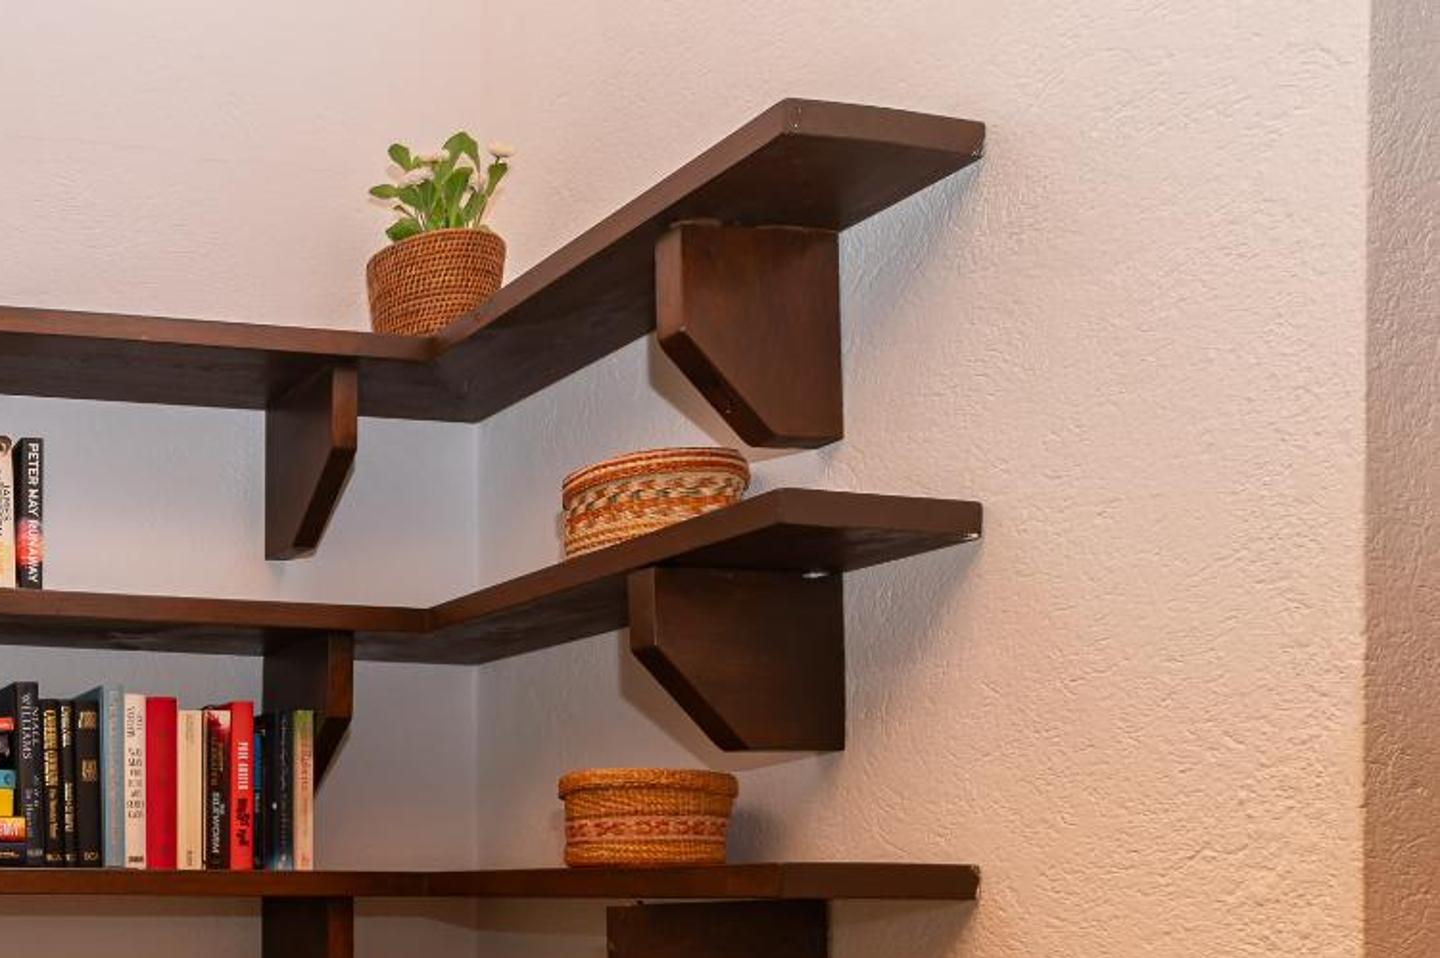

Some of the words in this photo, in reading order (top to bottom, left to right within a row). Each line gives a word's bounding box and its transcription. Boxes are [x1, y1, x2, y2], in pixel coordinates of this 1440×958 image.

[28, 442, 39, 485] PETER
[2, 484, 11, 521] JAMES
[28, 488, 39, 516] MAY
[27, 519, 39, 583] RUNAWAY
[21, 693, 33, 760] WILLIAMS
[32, 706, 40, 747] NIALL
[211, 791, 221, 854] SILKWORM
